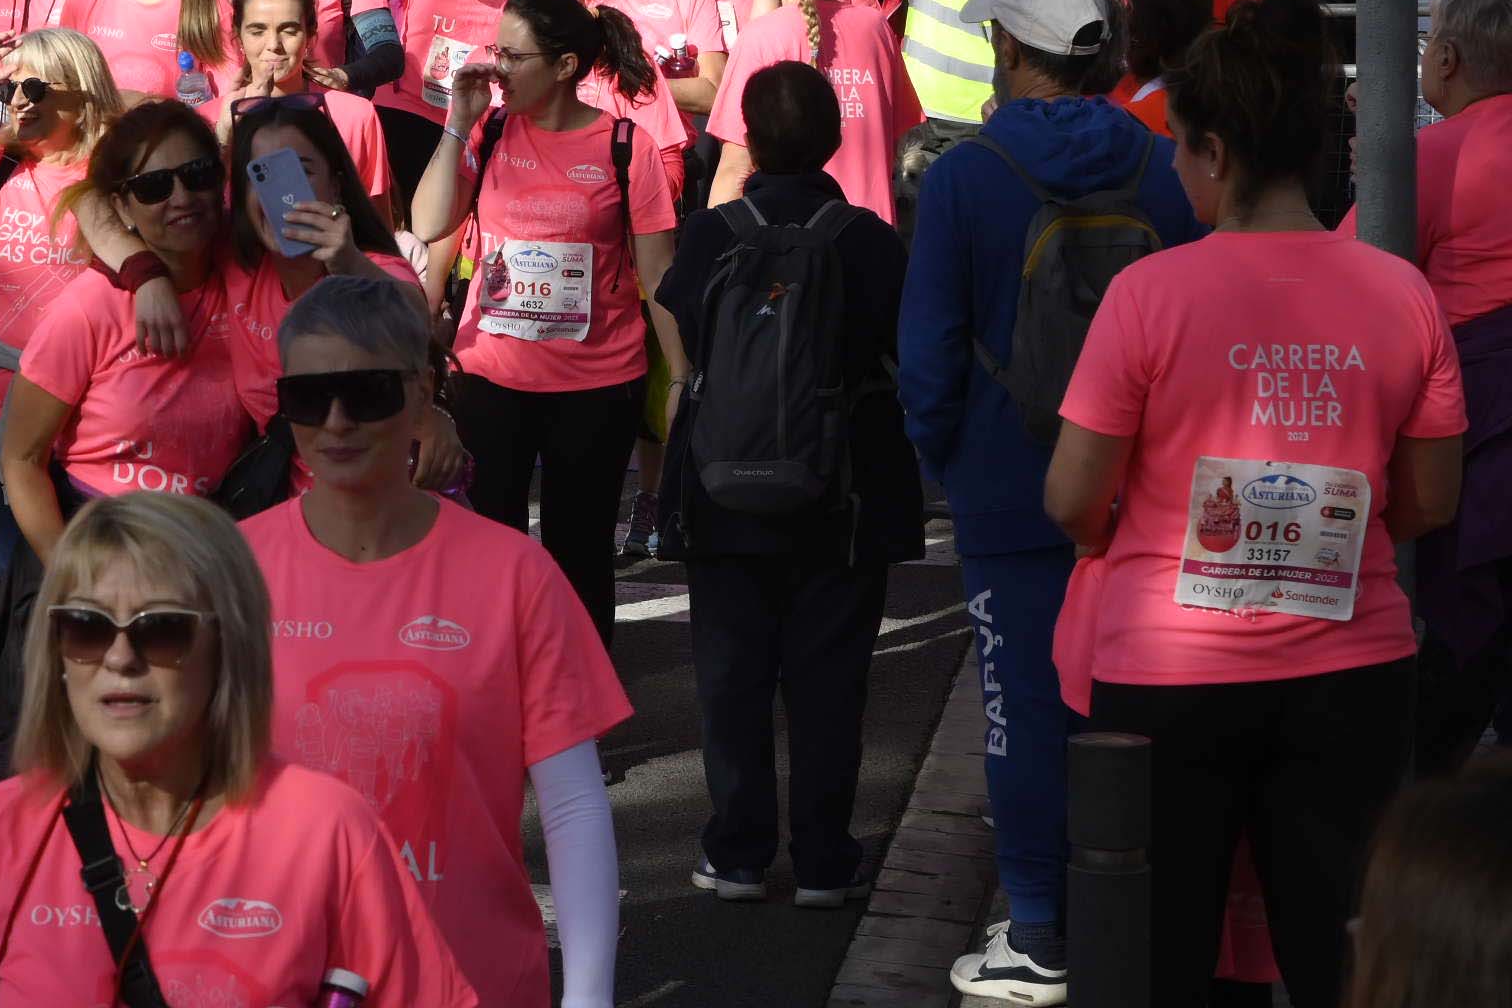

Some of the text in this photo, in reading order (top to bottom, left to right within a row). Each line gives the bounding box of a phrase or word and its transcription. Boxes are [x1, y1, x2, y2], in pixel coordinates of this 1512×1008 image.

[432, 14, 457, 33] TU
[840, 86, 861, 102] LA
[1, 207, 46, 228] HOY
[514, 281, 553, 297] 016
[520, 300, 544, 311] 4632
[1228, 343, 1366, 372] CARRERA
[1257, 372, 1338, 398] DE LA
[1250, 400, 1344, 428] MUJER
[1248, 485, 1311, 503] ASTURIANA
[1322, 486, 1358, 499] SUMA
[1244, 520, 1302, 544] 016
[1246, 548, 1292, 563] 33157
[1201, 564, 1246, 576] CARRERA
[1247, 567, 1263, 577] DE
[1263, 568, 1276, 578] LA
[1277, 569, 1314, 581] MUJER
[1192, 582, 1341, 607] OYSHO Santander
[404, 628, 466, 644] ASTURIANA
[203, 908, 276, 930] ASTURIANA
